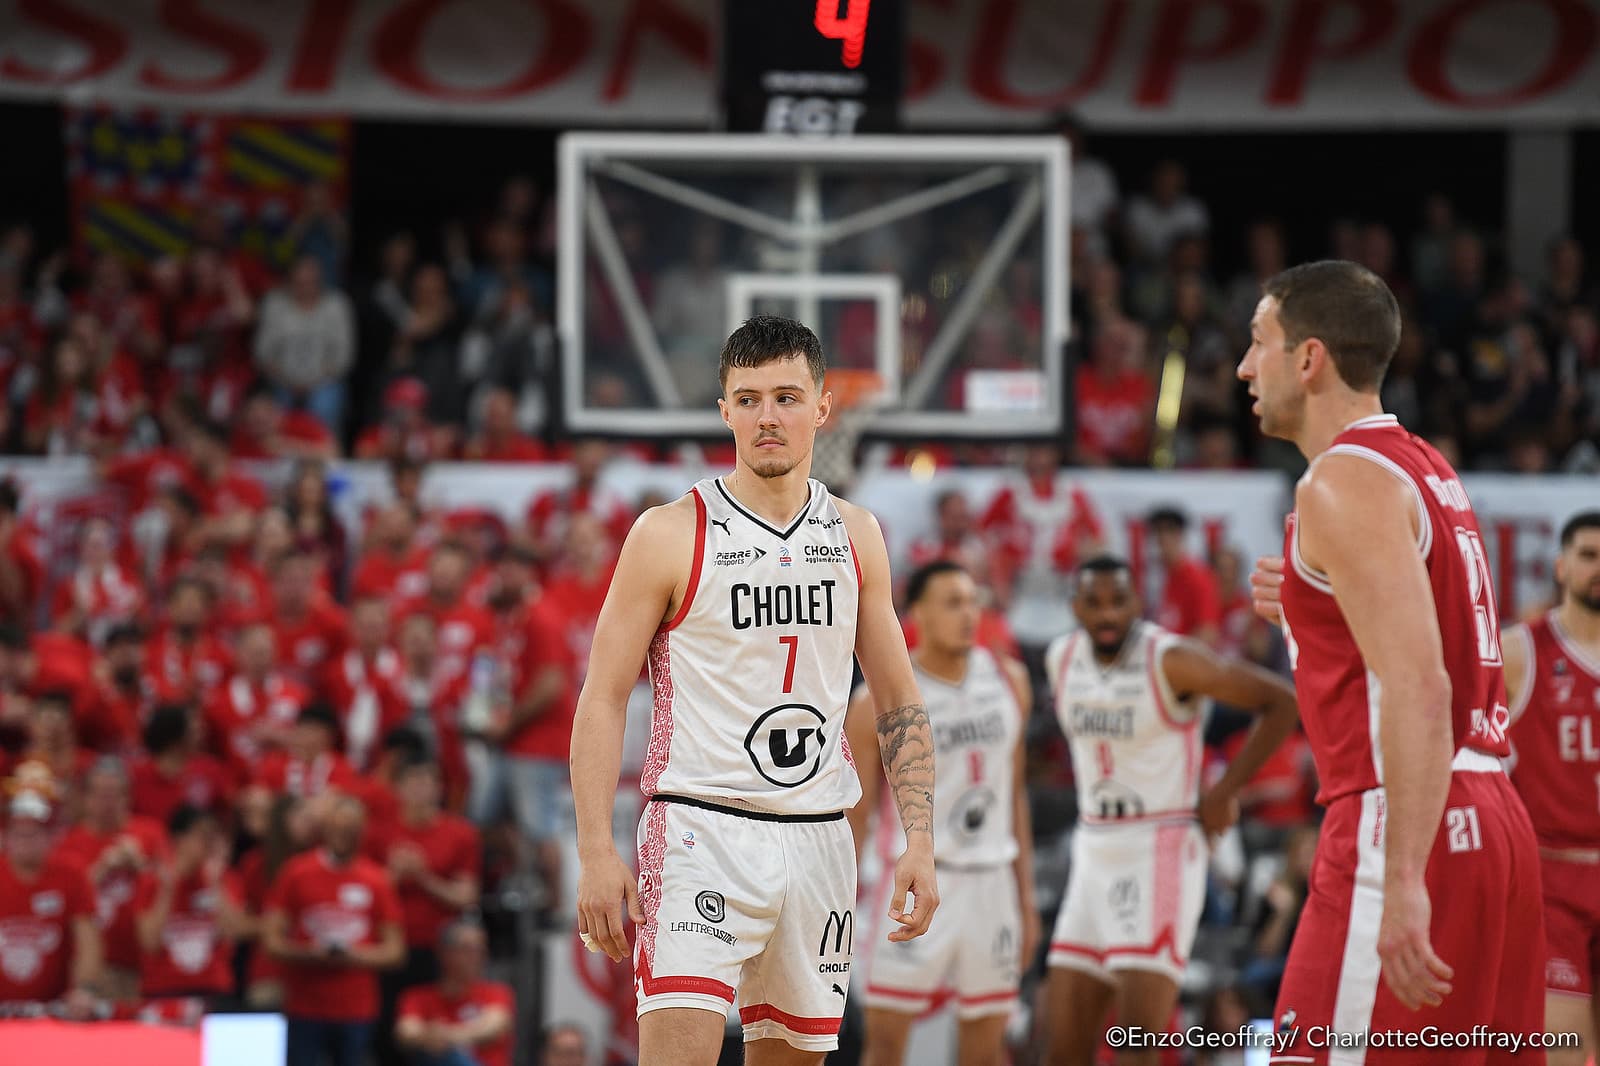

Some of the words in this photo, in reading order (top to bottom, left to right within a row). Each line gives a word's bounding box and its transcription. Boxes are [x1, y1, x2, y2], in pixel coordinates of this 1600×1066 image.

[731, 580, 836, 630] CHOLET
[779, 635, 799, 694] 7
[1446, 805, 1483, 853] 21
